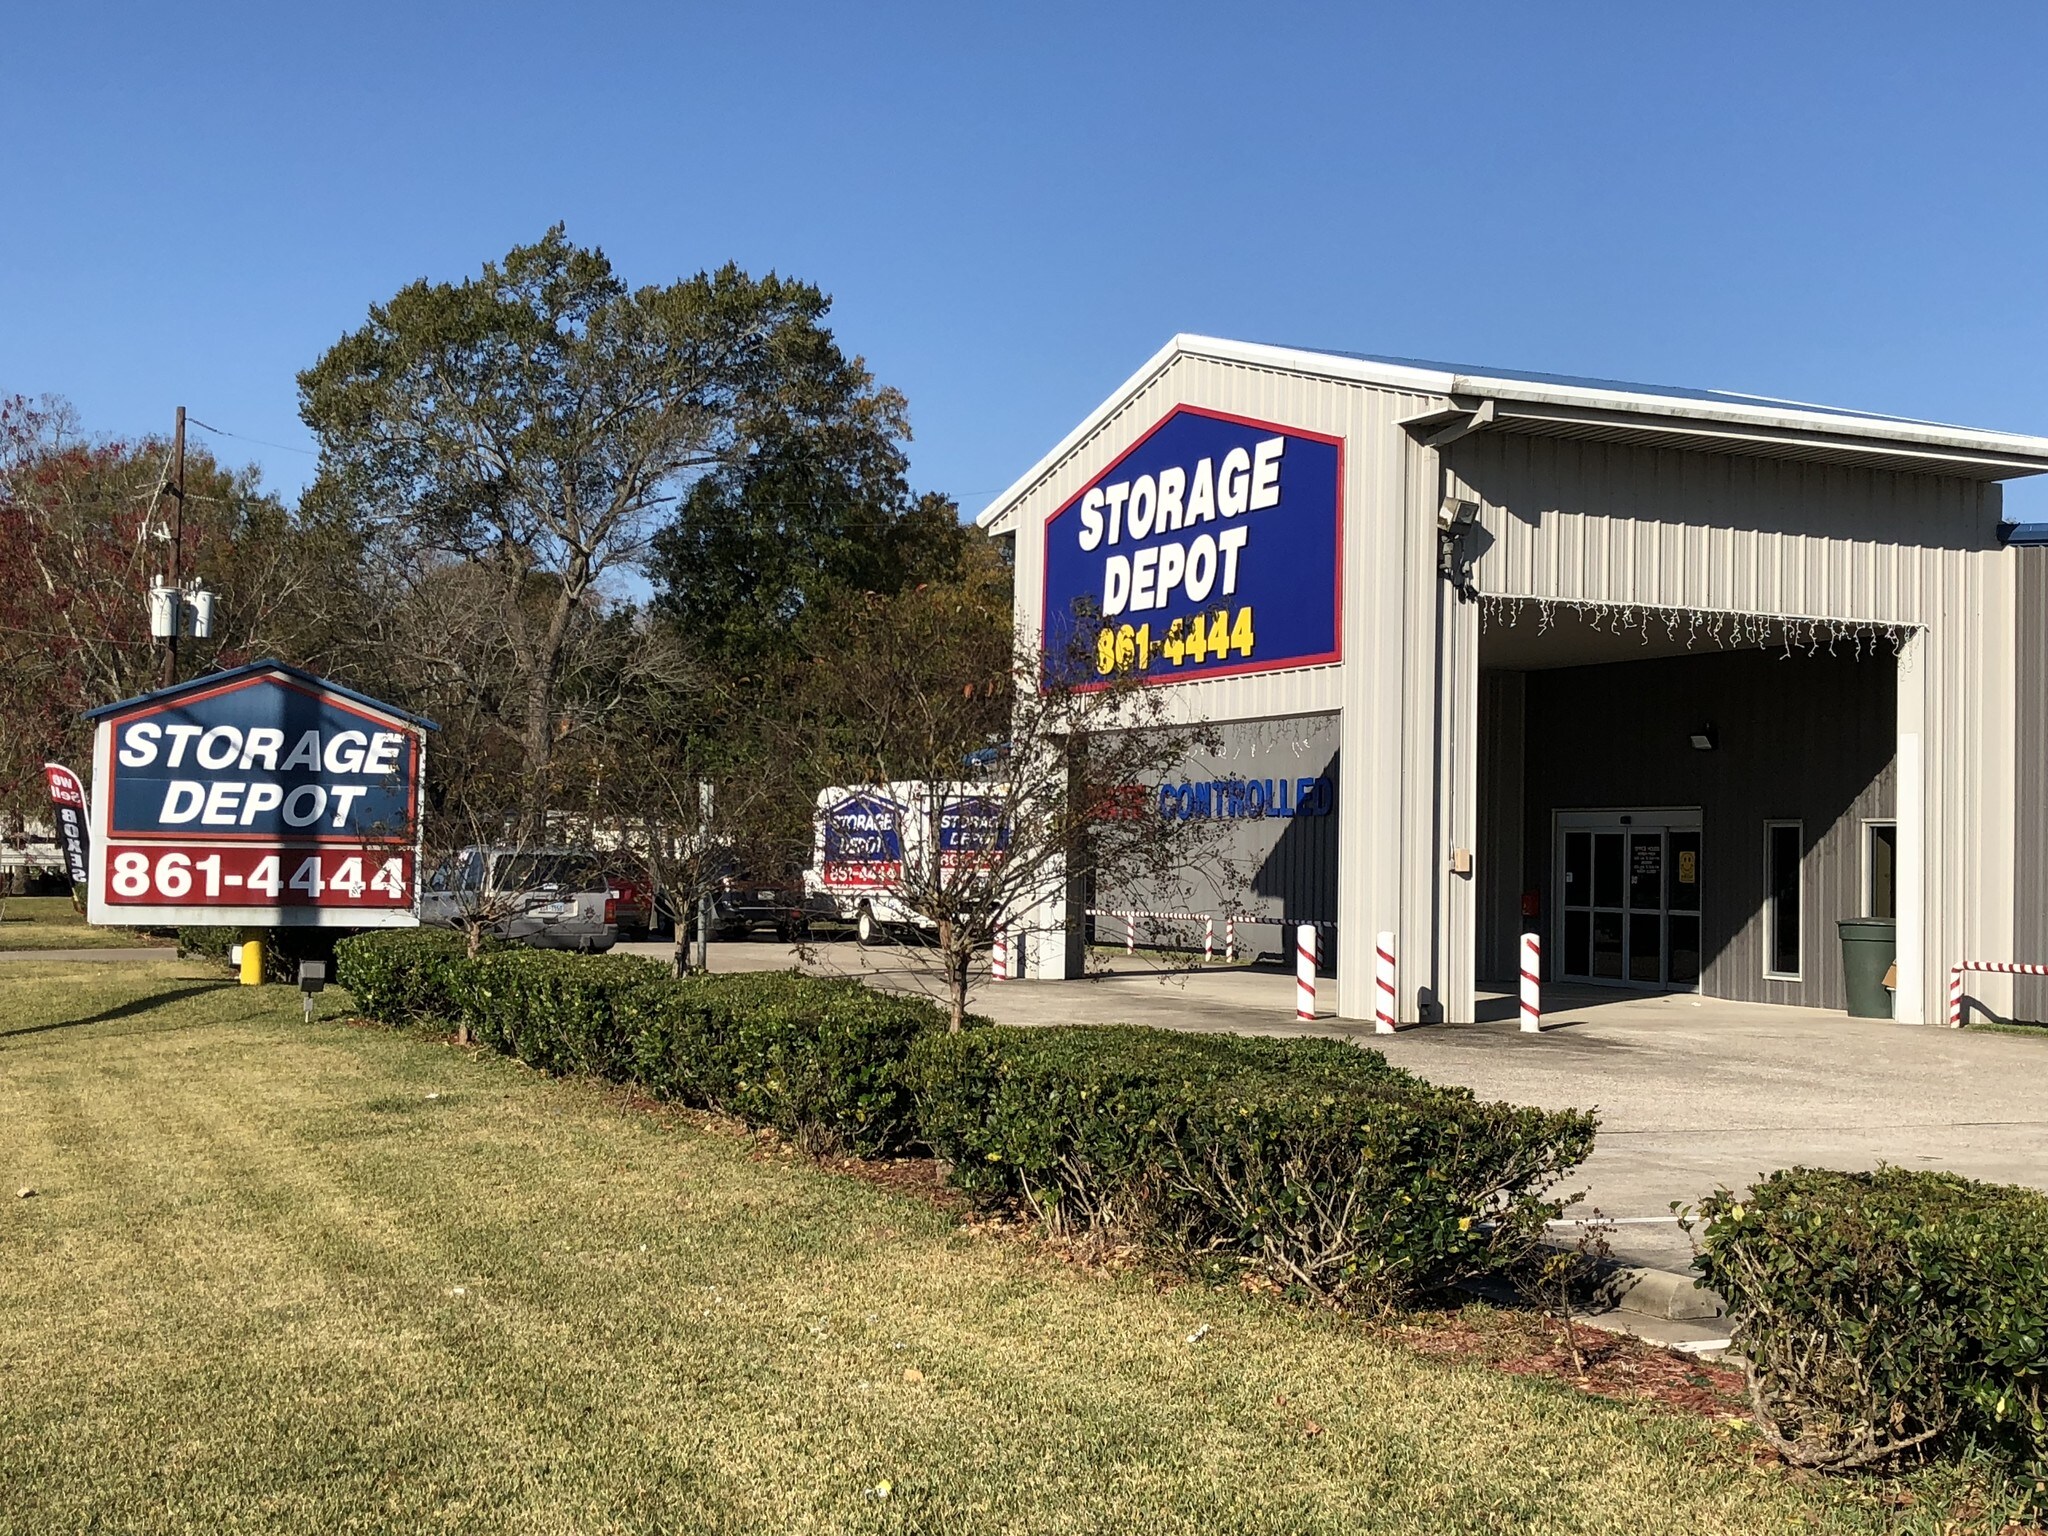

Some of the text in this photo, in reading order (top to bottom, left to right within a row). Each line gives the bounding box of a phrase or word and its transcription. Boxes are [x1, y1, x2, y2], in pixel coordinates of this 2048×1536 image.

[1078, 436, 1285, 552] STORAGE
[1102, 525, 1248, 617] DEPOT
[1097, 606, 1254, 675] 861-4444
[119, 722, 402, 774] STORAGE
[158, 780, 368, 828] DEPOT
[1159, 777, 1334, 820] CONTROLLED
[111, 852, 407, 898] 861-4444
